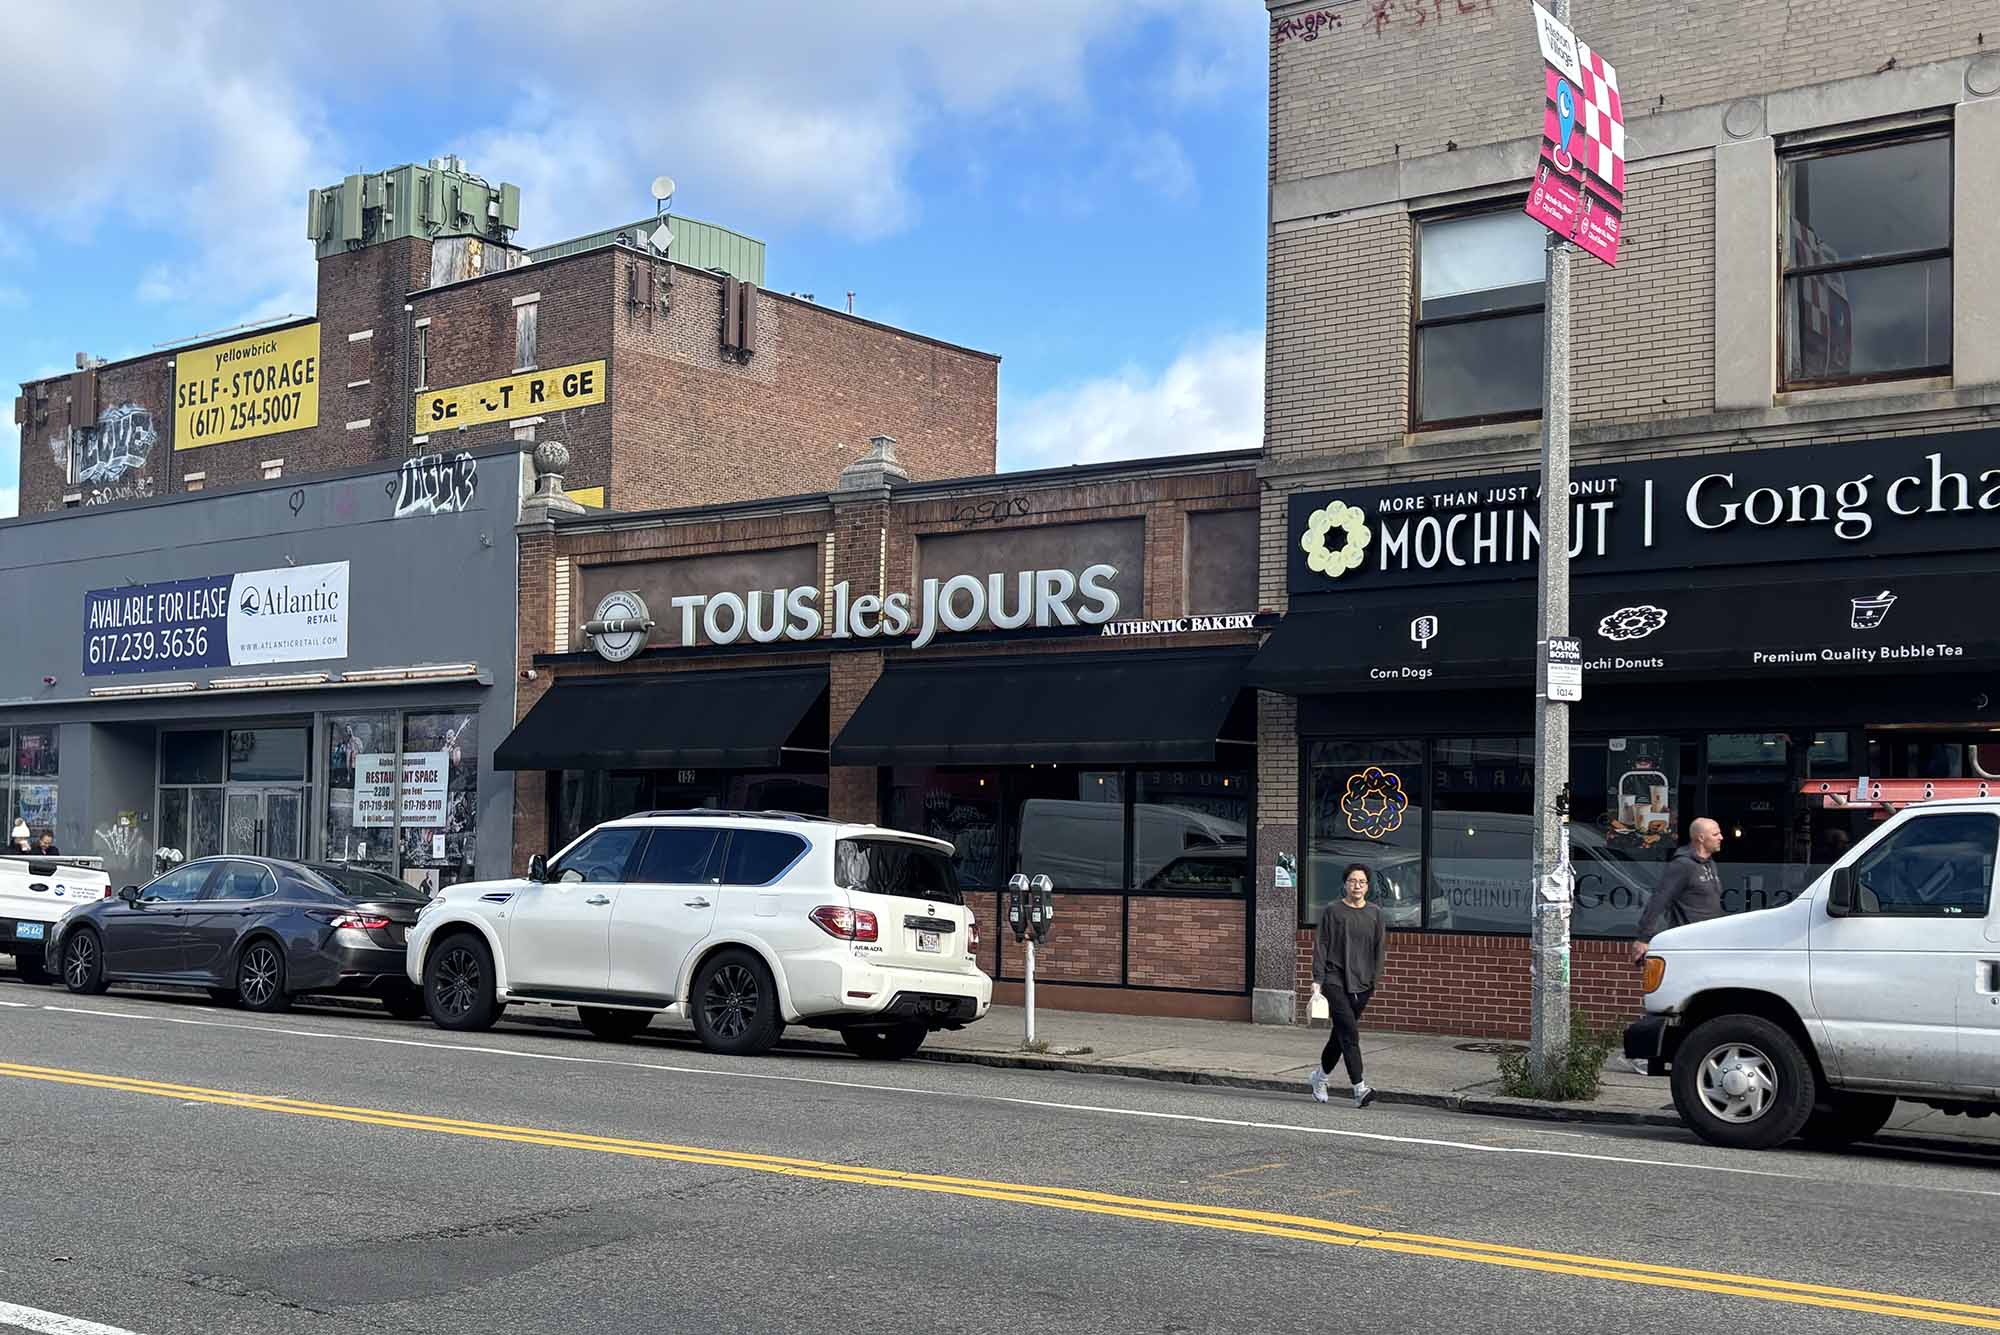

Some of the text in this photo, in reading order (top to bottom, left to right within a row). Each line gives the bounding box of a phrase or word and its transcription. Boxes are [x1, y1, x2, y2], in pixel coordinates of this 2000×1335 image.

[216, 340, 277, 371] yellowbrick
[178, 357, 315, 408] SELF-STORAGE
[190, 392, 301, 439] (617) 254-5007
[1379, 496, 1425, 512] MORE
[1433, 491, 1478, 507] THAN
[1487, 486, 1528, 503] JUST
[1568, 478, 1617, 496] ONUT
[1686, 453, 2000, 539] Gong cha
[89, 587, 227, 629] AVAILABLE FOR LEASE
[261, 582, 338, 616] Atlantic
[672, 564, 1120, 649] TOUS les JOURS
[307, 614, 338, 625] RETAIL
[1101, 614, 1256, 637] AUTHENTIC BAKERY
[89, 627, 208, 664] 617.239.3636
[240, 636, 338, 651] WWW.ATLANTICRETAIL.COM
[1549, 639, 1580, 651] PARK
[1549, 650, 1580, 660] BOSTON
[1753, 644, 1963, 664] Premium Quality Bubble Tea
[1370, 667, 1433, 680] Corn Dogs
[1583, 657, 1664, 670] ochi Donuts
[415, 770, 438, 783] SPACE
